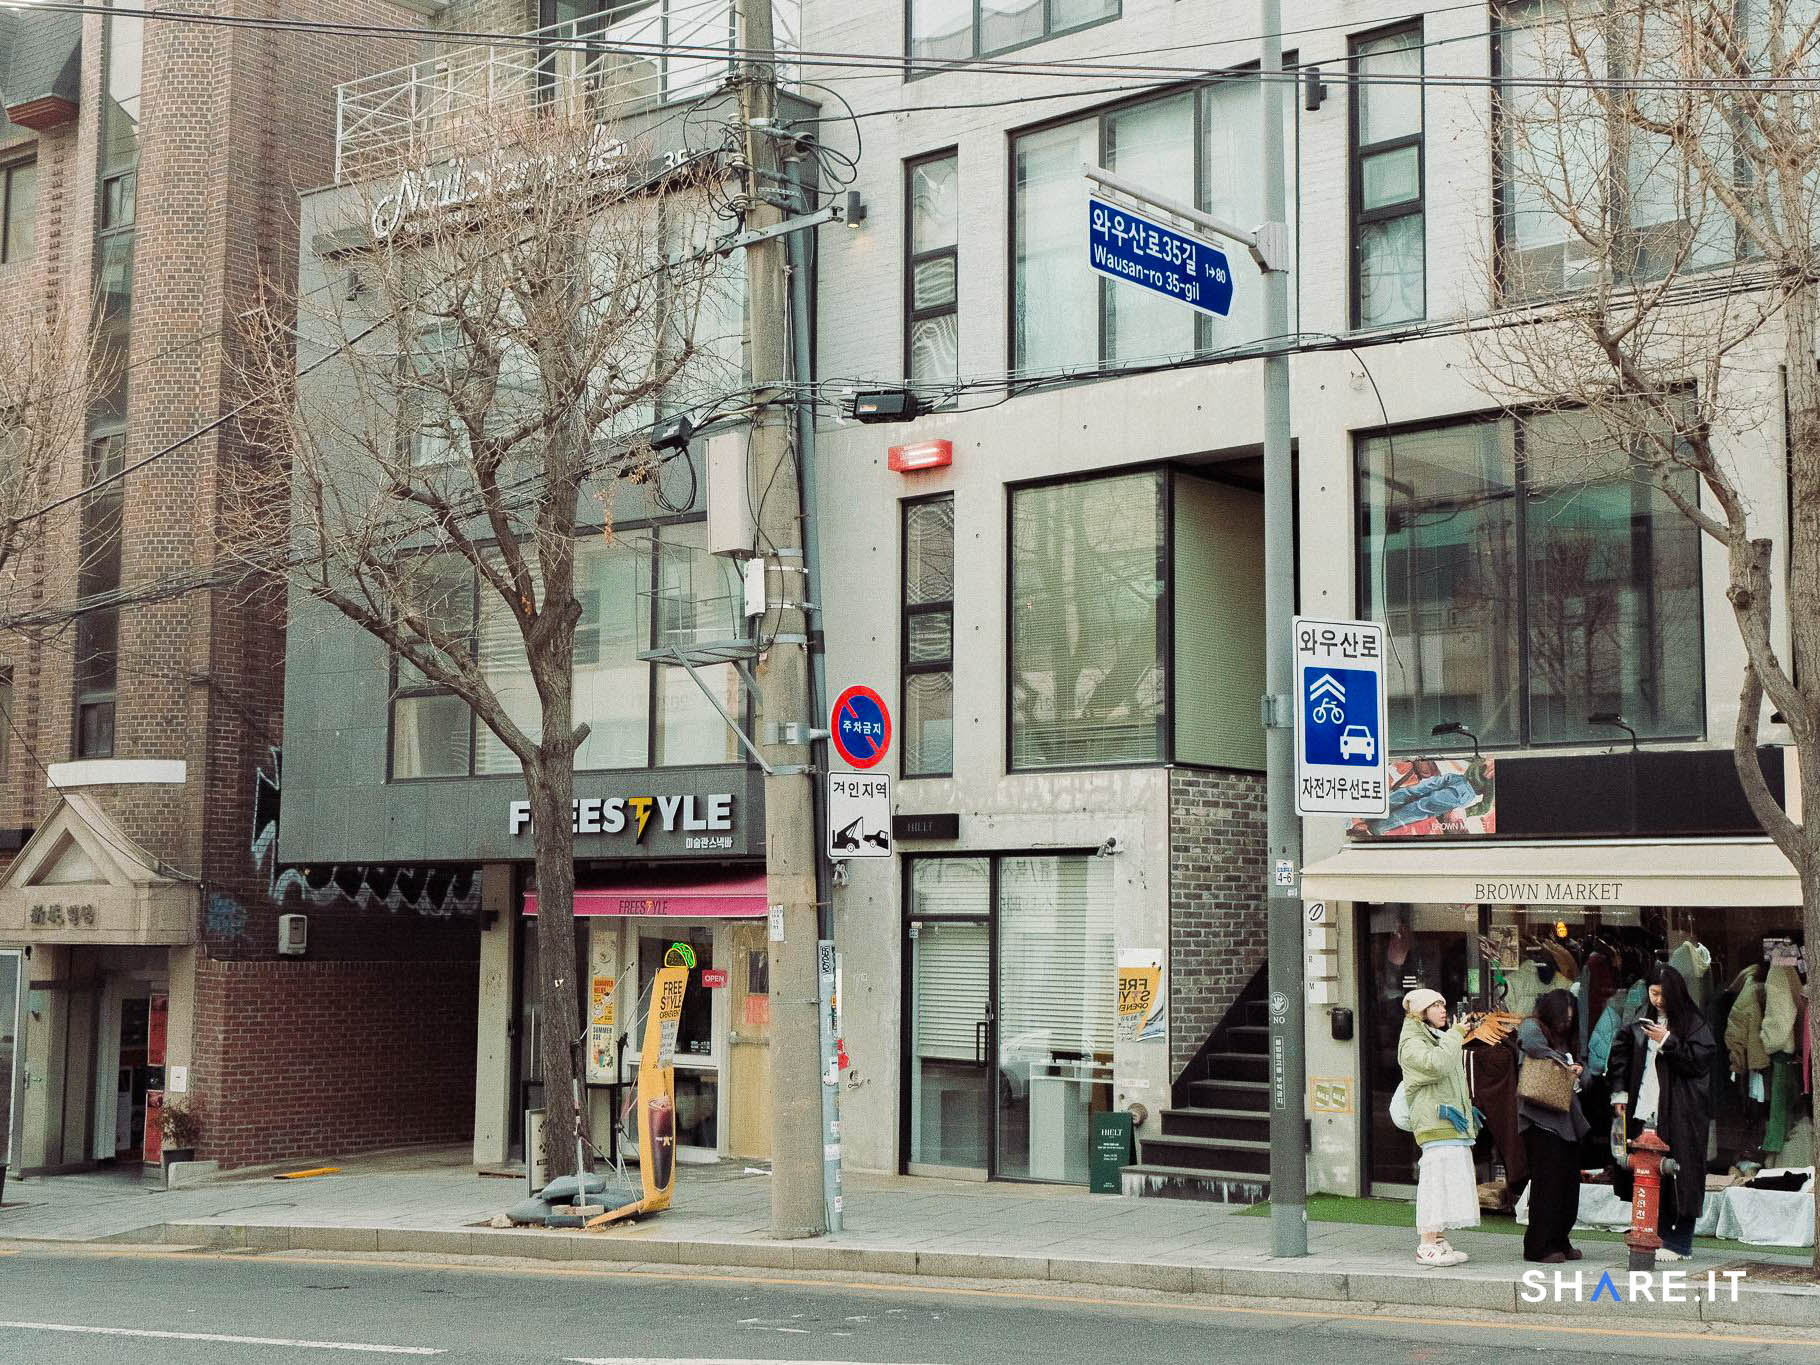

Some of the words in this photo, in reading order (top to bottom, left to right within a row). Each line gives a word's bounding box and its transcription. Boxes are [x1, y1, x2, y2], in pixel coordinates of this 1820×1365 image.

[1093, 208, 1197, 277] 와우산로35길
[1093, 243, 1163, 287] Wausan-ro
[1165, 271, 1200, 301] 35-gil
[1300, 628, 1379, 659] 와우산로
[843, 719, 882, 736] 주차금지
[1302, 775, 1383, 801] 자전거우선도로
[509, 793, 732, 840] FESTYLE
[1431, 821, 1458, 832] BROWN
[685, 836, 733, 849] 미술관스낵바
[1278, 872, 1292, 884] 4-6
[1475, 882, 1539, 901] BROWN
[1546, 882, 1623, 901] MARKET
[618, 900, 668, 915] FREESTYLE
[704, 974, 726, 983] OPEN
[663, 980, 683, 996] FREE
[1273, 1016, 1286, 1024] NO
